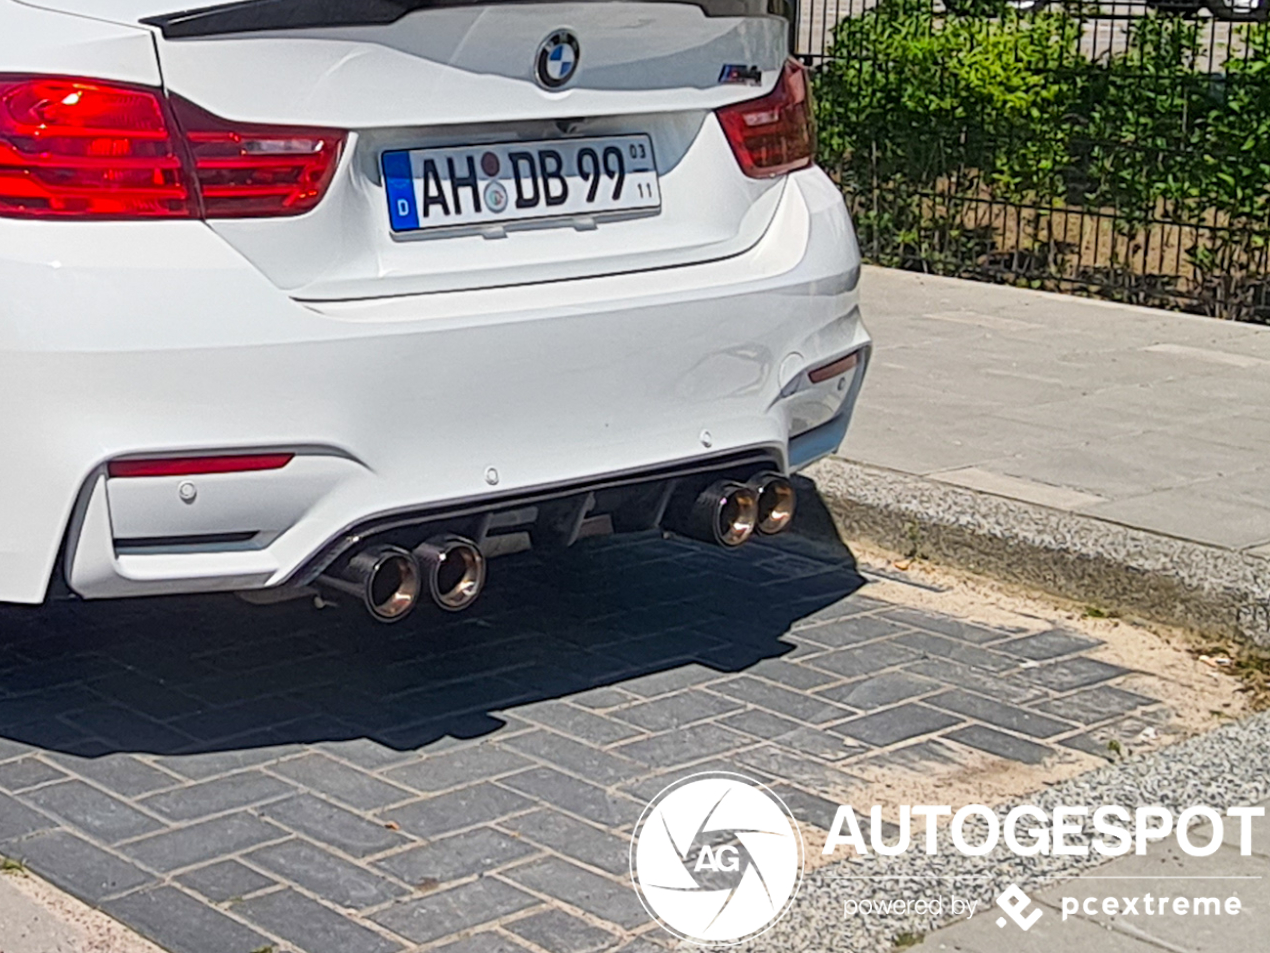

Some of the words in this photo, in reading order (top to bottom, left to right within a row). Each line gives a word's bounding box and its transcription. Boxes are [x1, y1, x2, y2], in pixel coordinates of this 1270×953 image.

[630, 143, 646, 159] 03
[422, 155, 482, 218] AH
[508, 149, 569, 209] DB
[577, 146, 626, 203] 99
[637, 182, 652, 198] 11
[397, 198, 409, 216] D
